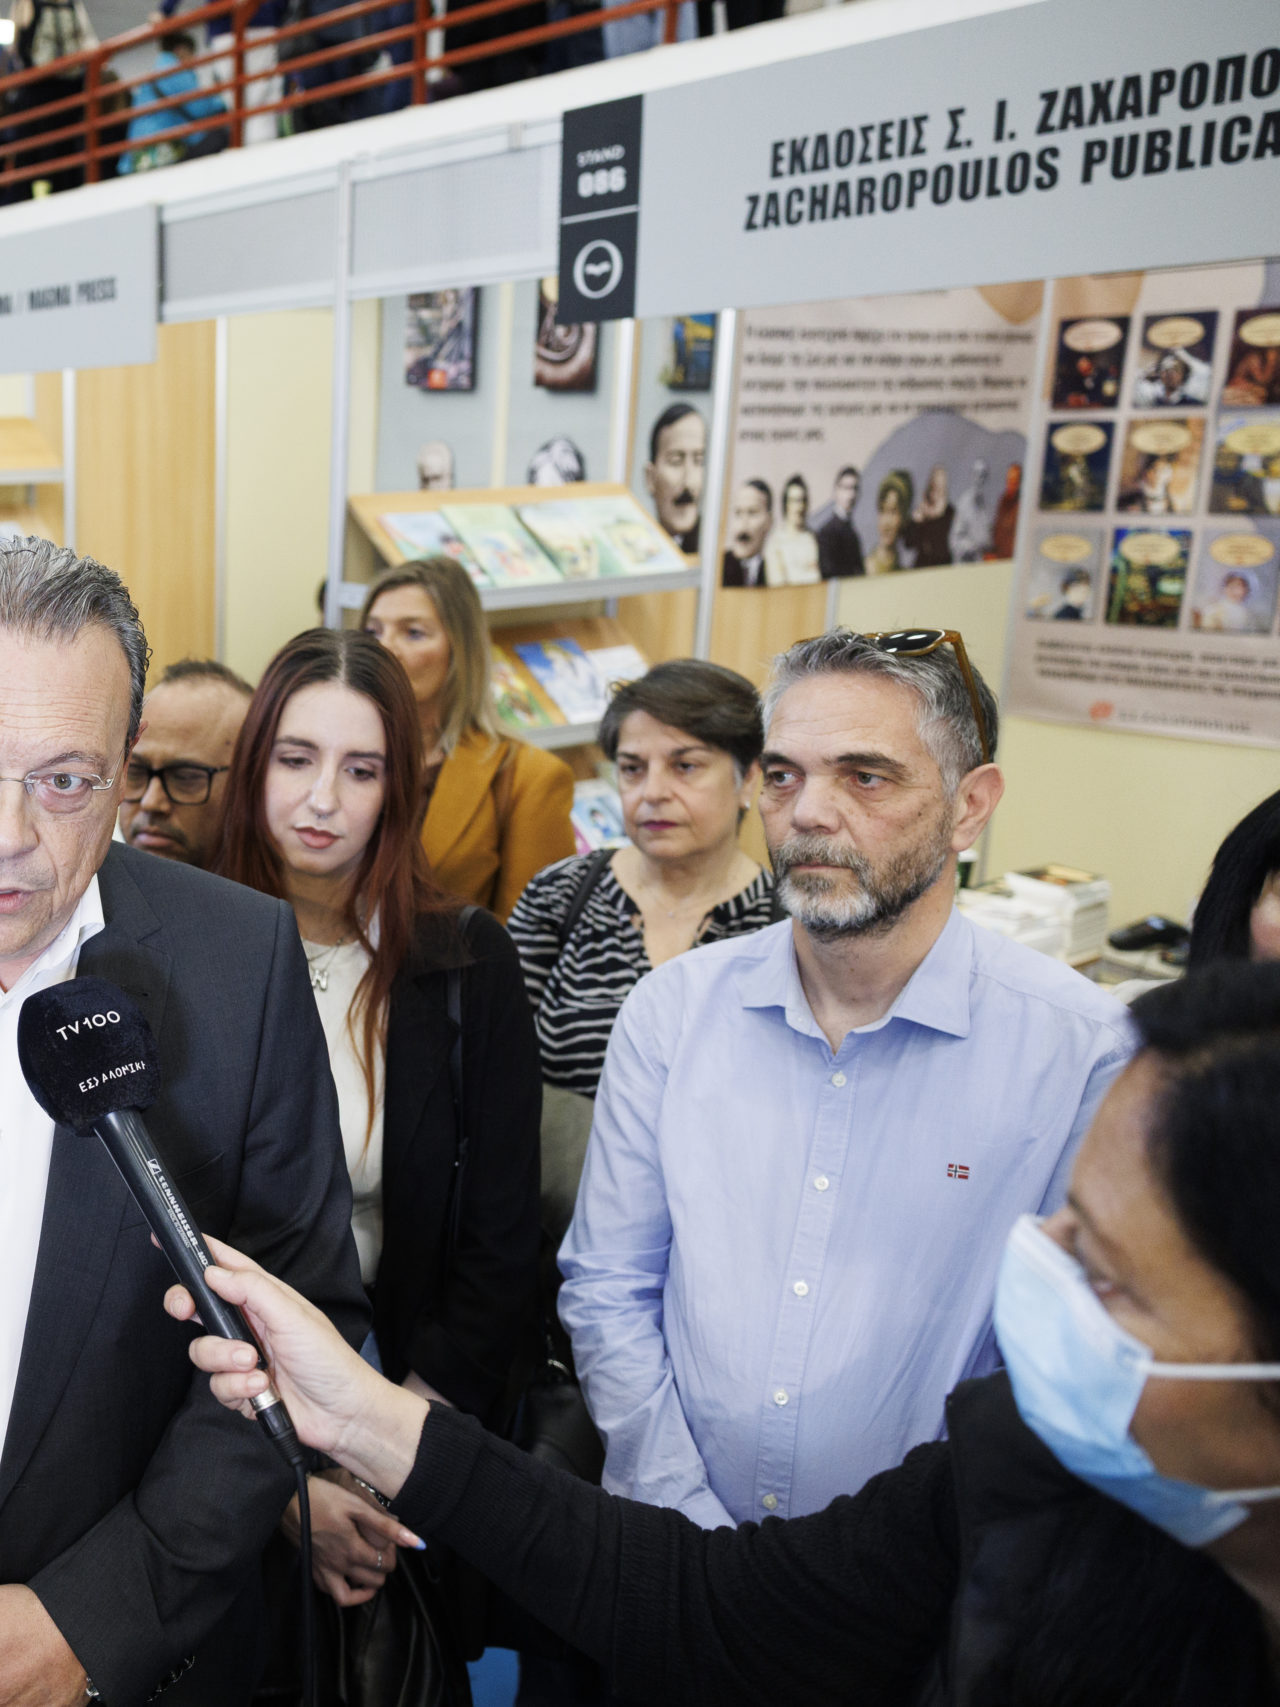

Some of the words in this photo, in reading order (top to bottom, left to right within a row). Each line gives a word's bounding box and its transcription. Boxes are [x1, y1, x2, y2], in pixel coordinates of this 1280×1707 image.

[577, 145, 625, 167] STAND
[769, 113, 930, 179] ΕΚΔΟΣΕΙΣ
[945, 107, 973, 151] Σ.
[1035, 48, 1280, 136] ΖΑΧΑΡΟΠΟ
[743, 146, 1060, 231] ZACHAROPOULOS
[1080, 110, 1280, 184] PUBLICA
[158, 1175, 198, 1247] SENNHEISER
